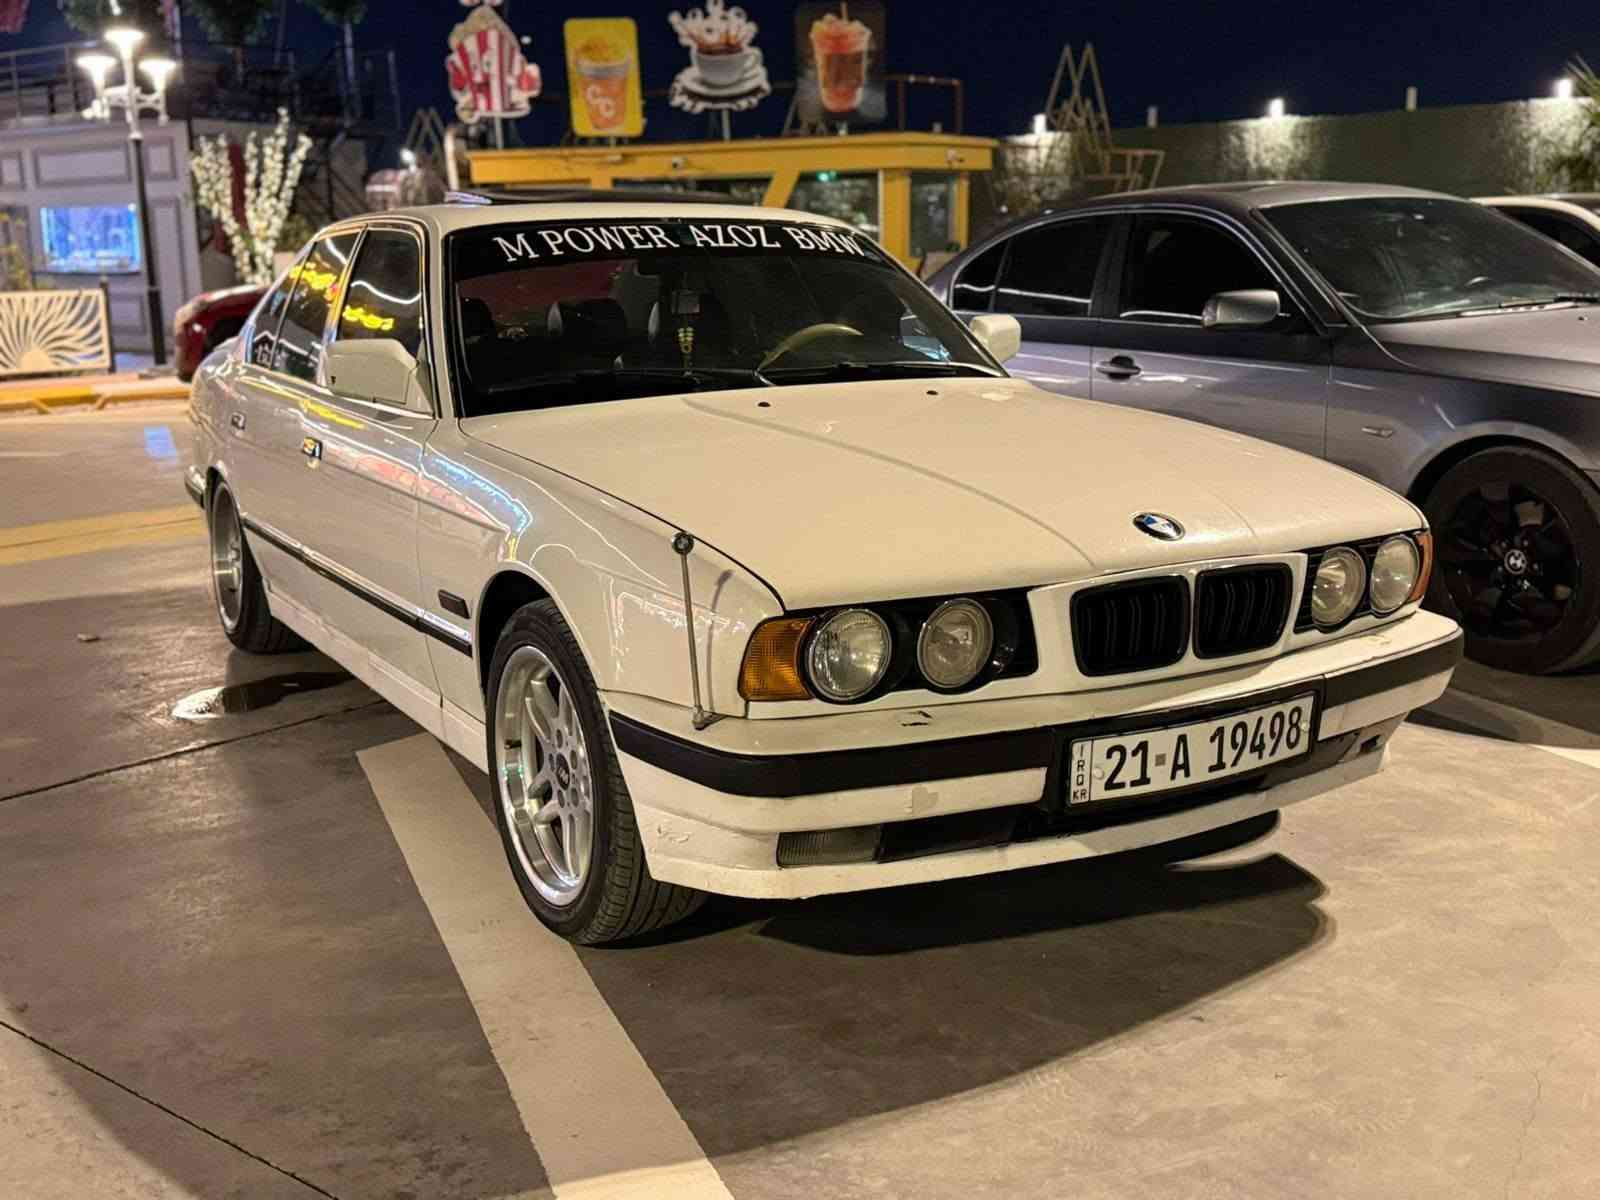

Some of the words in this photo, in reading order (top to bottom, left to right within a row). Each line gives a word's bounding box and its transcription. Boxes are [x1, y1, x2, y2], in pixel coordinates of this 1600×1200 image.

[492, 233, 540, 262] M
[537, 225, 680, 255] POWER
[688, 224, 782, 248] AZOZ
[782, 226, 865, 257] BMW
[1208, 706, 1303, 773] 19498
